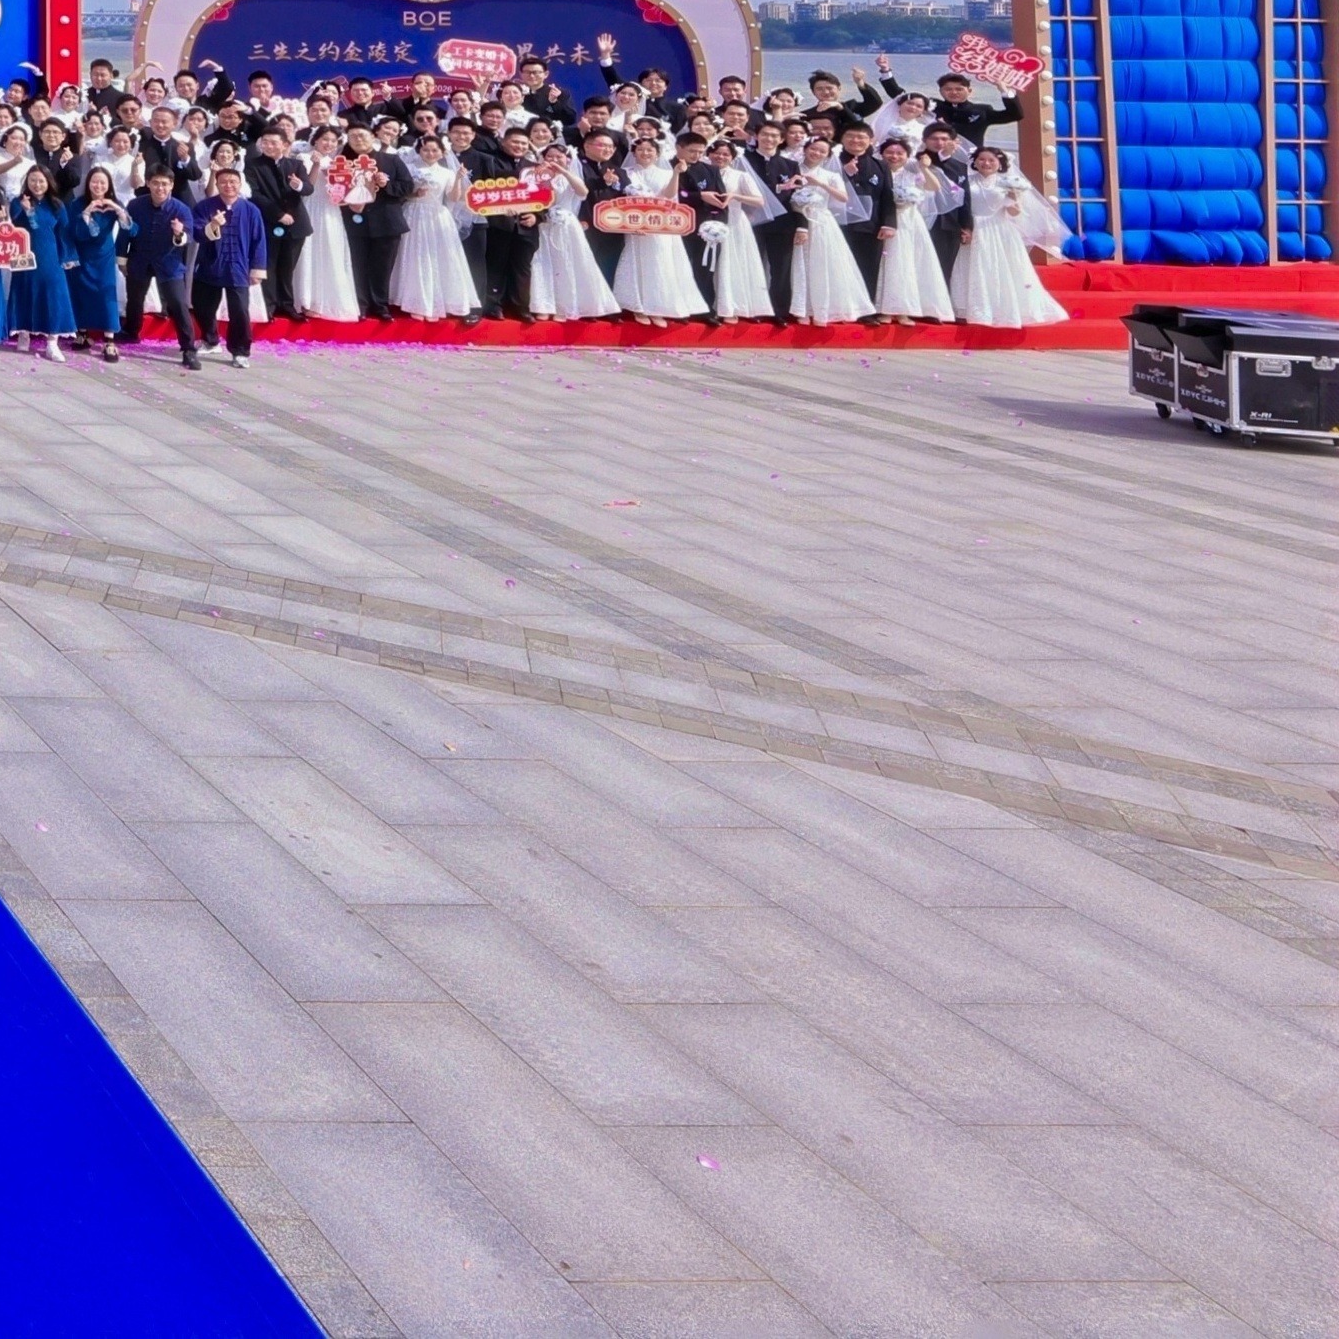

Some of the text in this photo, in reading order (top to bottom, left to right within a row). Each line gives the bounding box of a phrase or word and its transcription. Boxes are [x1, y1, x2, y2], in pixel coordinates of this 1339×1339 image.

[403, 11, 452, 30] BOE
[247, 40, 419, 64] 三生之约金陵定
[472, 190, 530, 204] 岁岁年年
[607, 214, 682, 226] 一世情深
